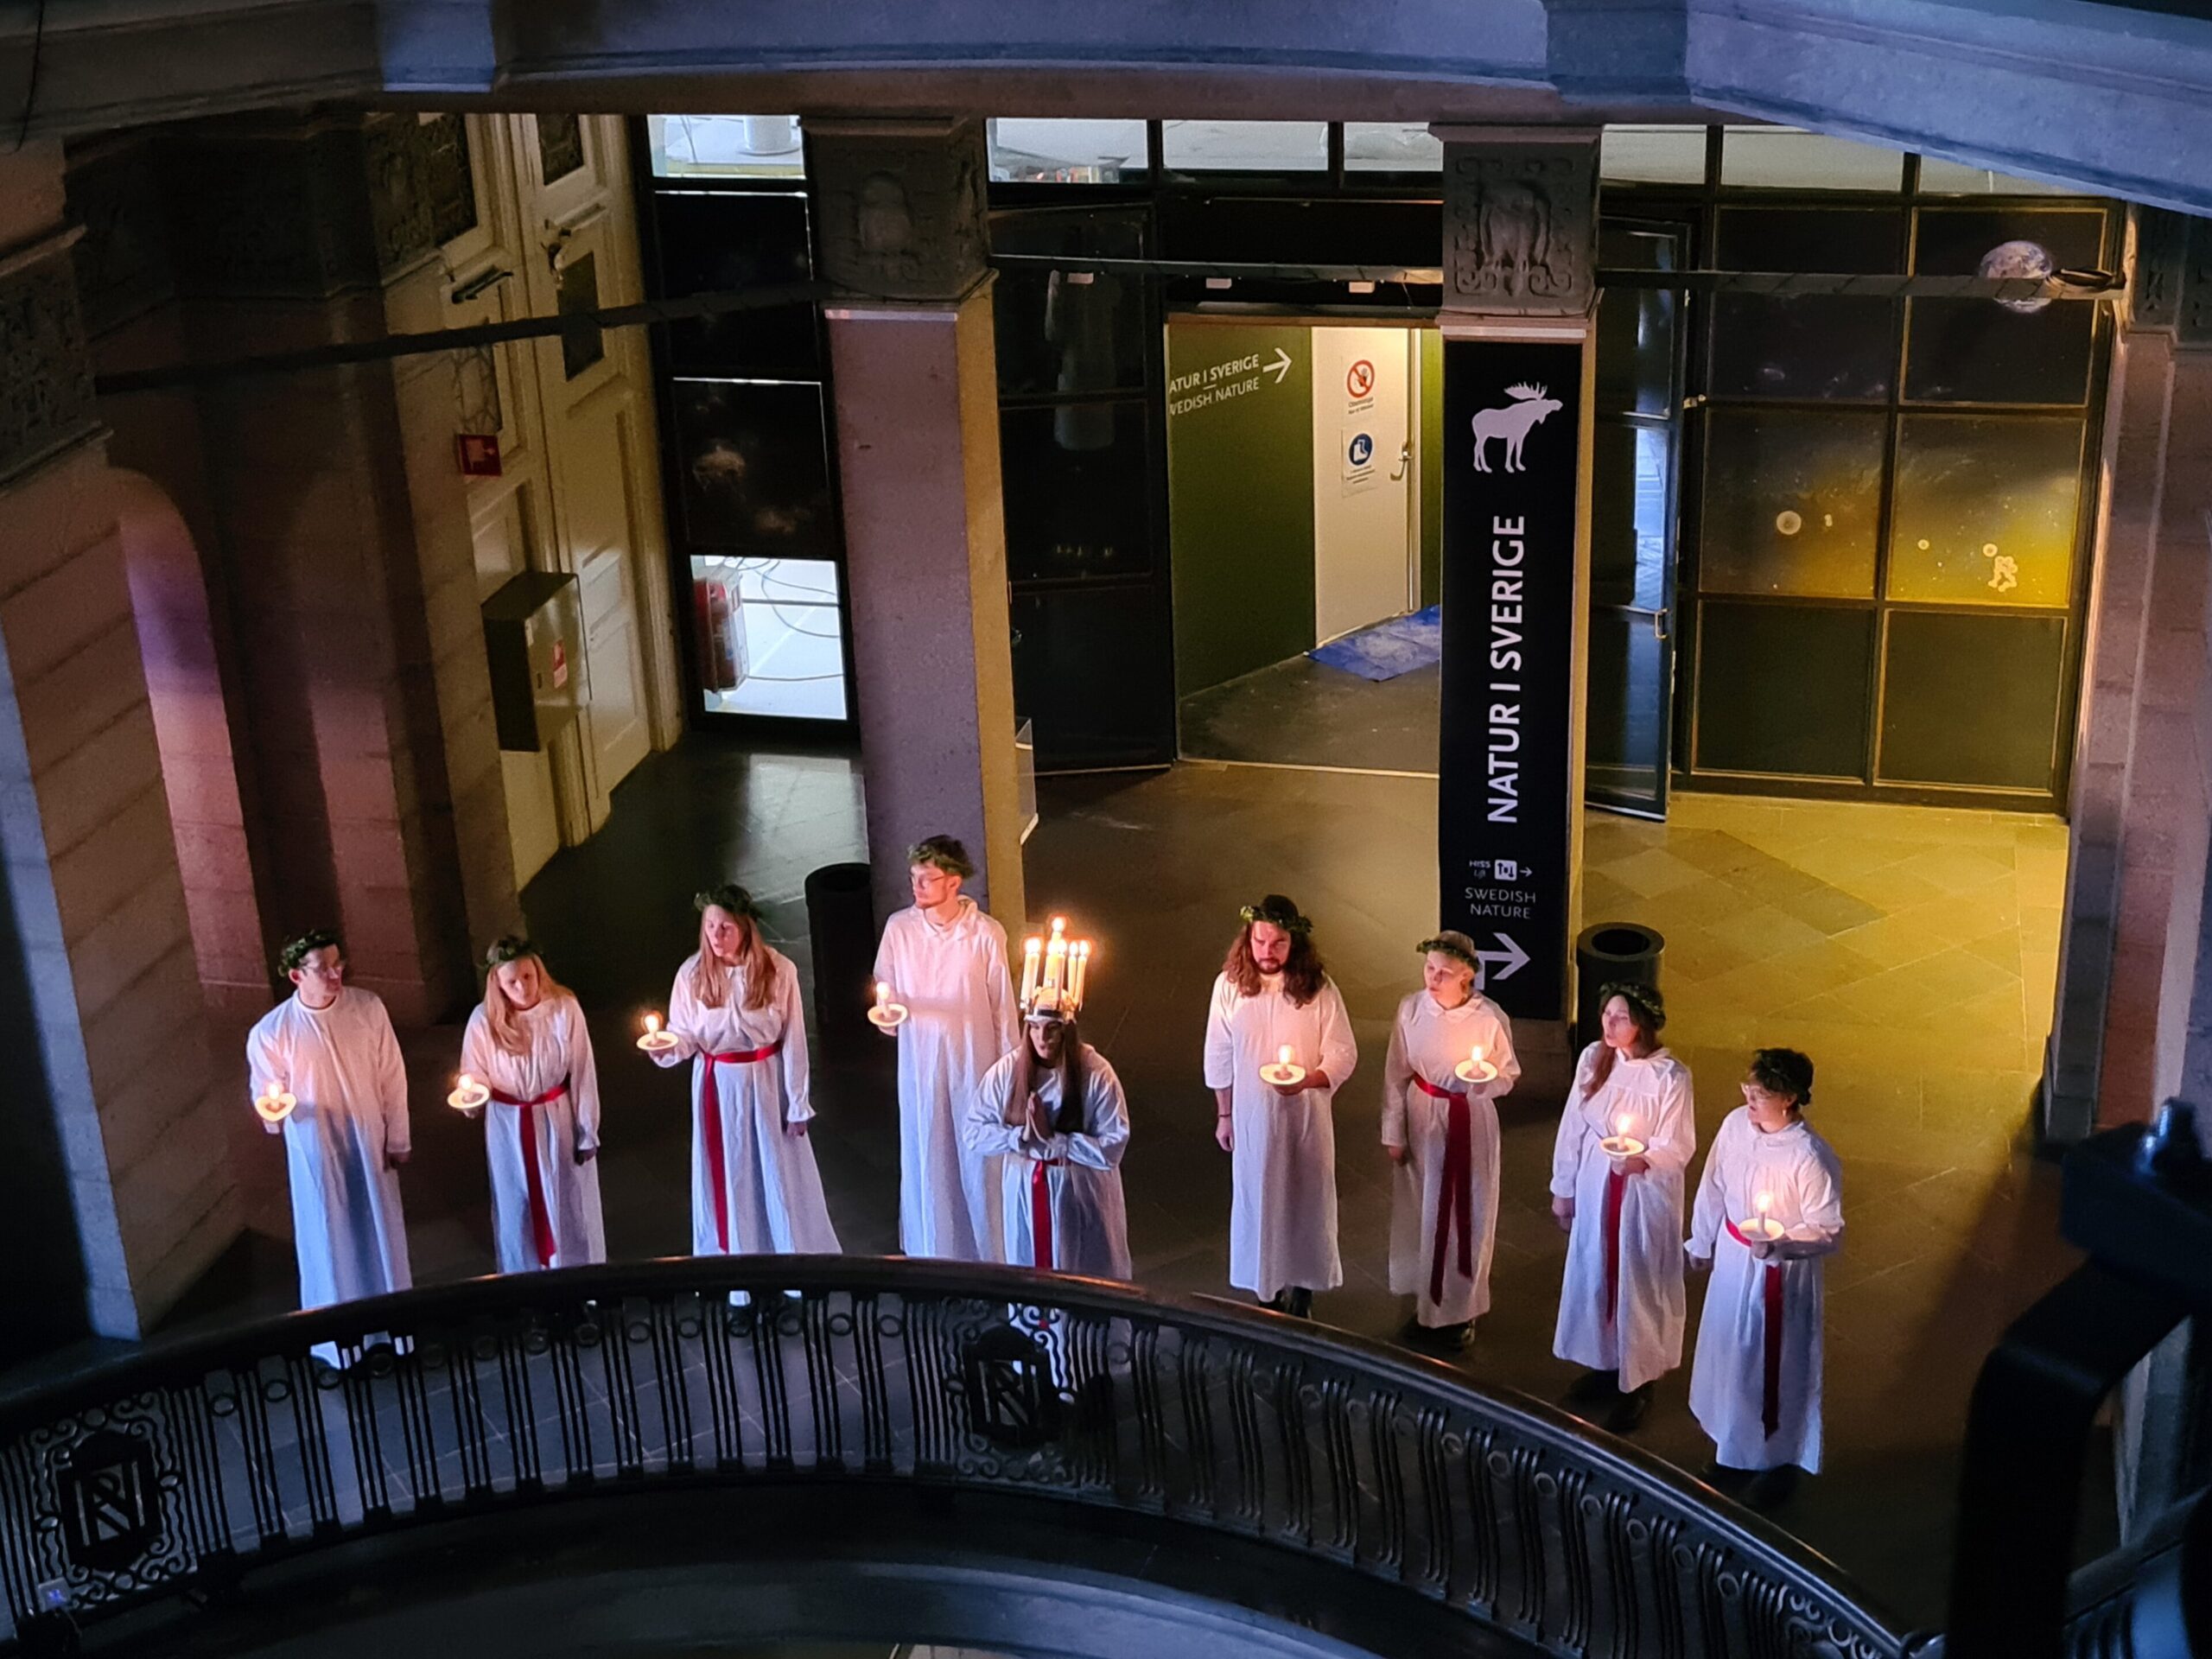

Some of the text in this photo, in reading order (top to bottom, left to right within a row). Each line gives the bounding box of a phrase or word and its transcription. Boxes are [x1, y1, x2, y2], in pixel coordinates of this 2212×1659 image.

[1169, 353, 1260, 394] ATUR I SVERIGE
[1215, 377, 1260, 402] NATURE
[1487, 516, 1525, 823] NATUR I SVERIGE
[1469, 860, 1491, 868] HISS
[1465, 887, 1536, 904] SWEDISH
[1470, 904, 1531, 919] NATURE
